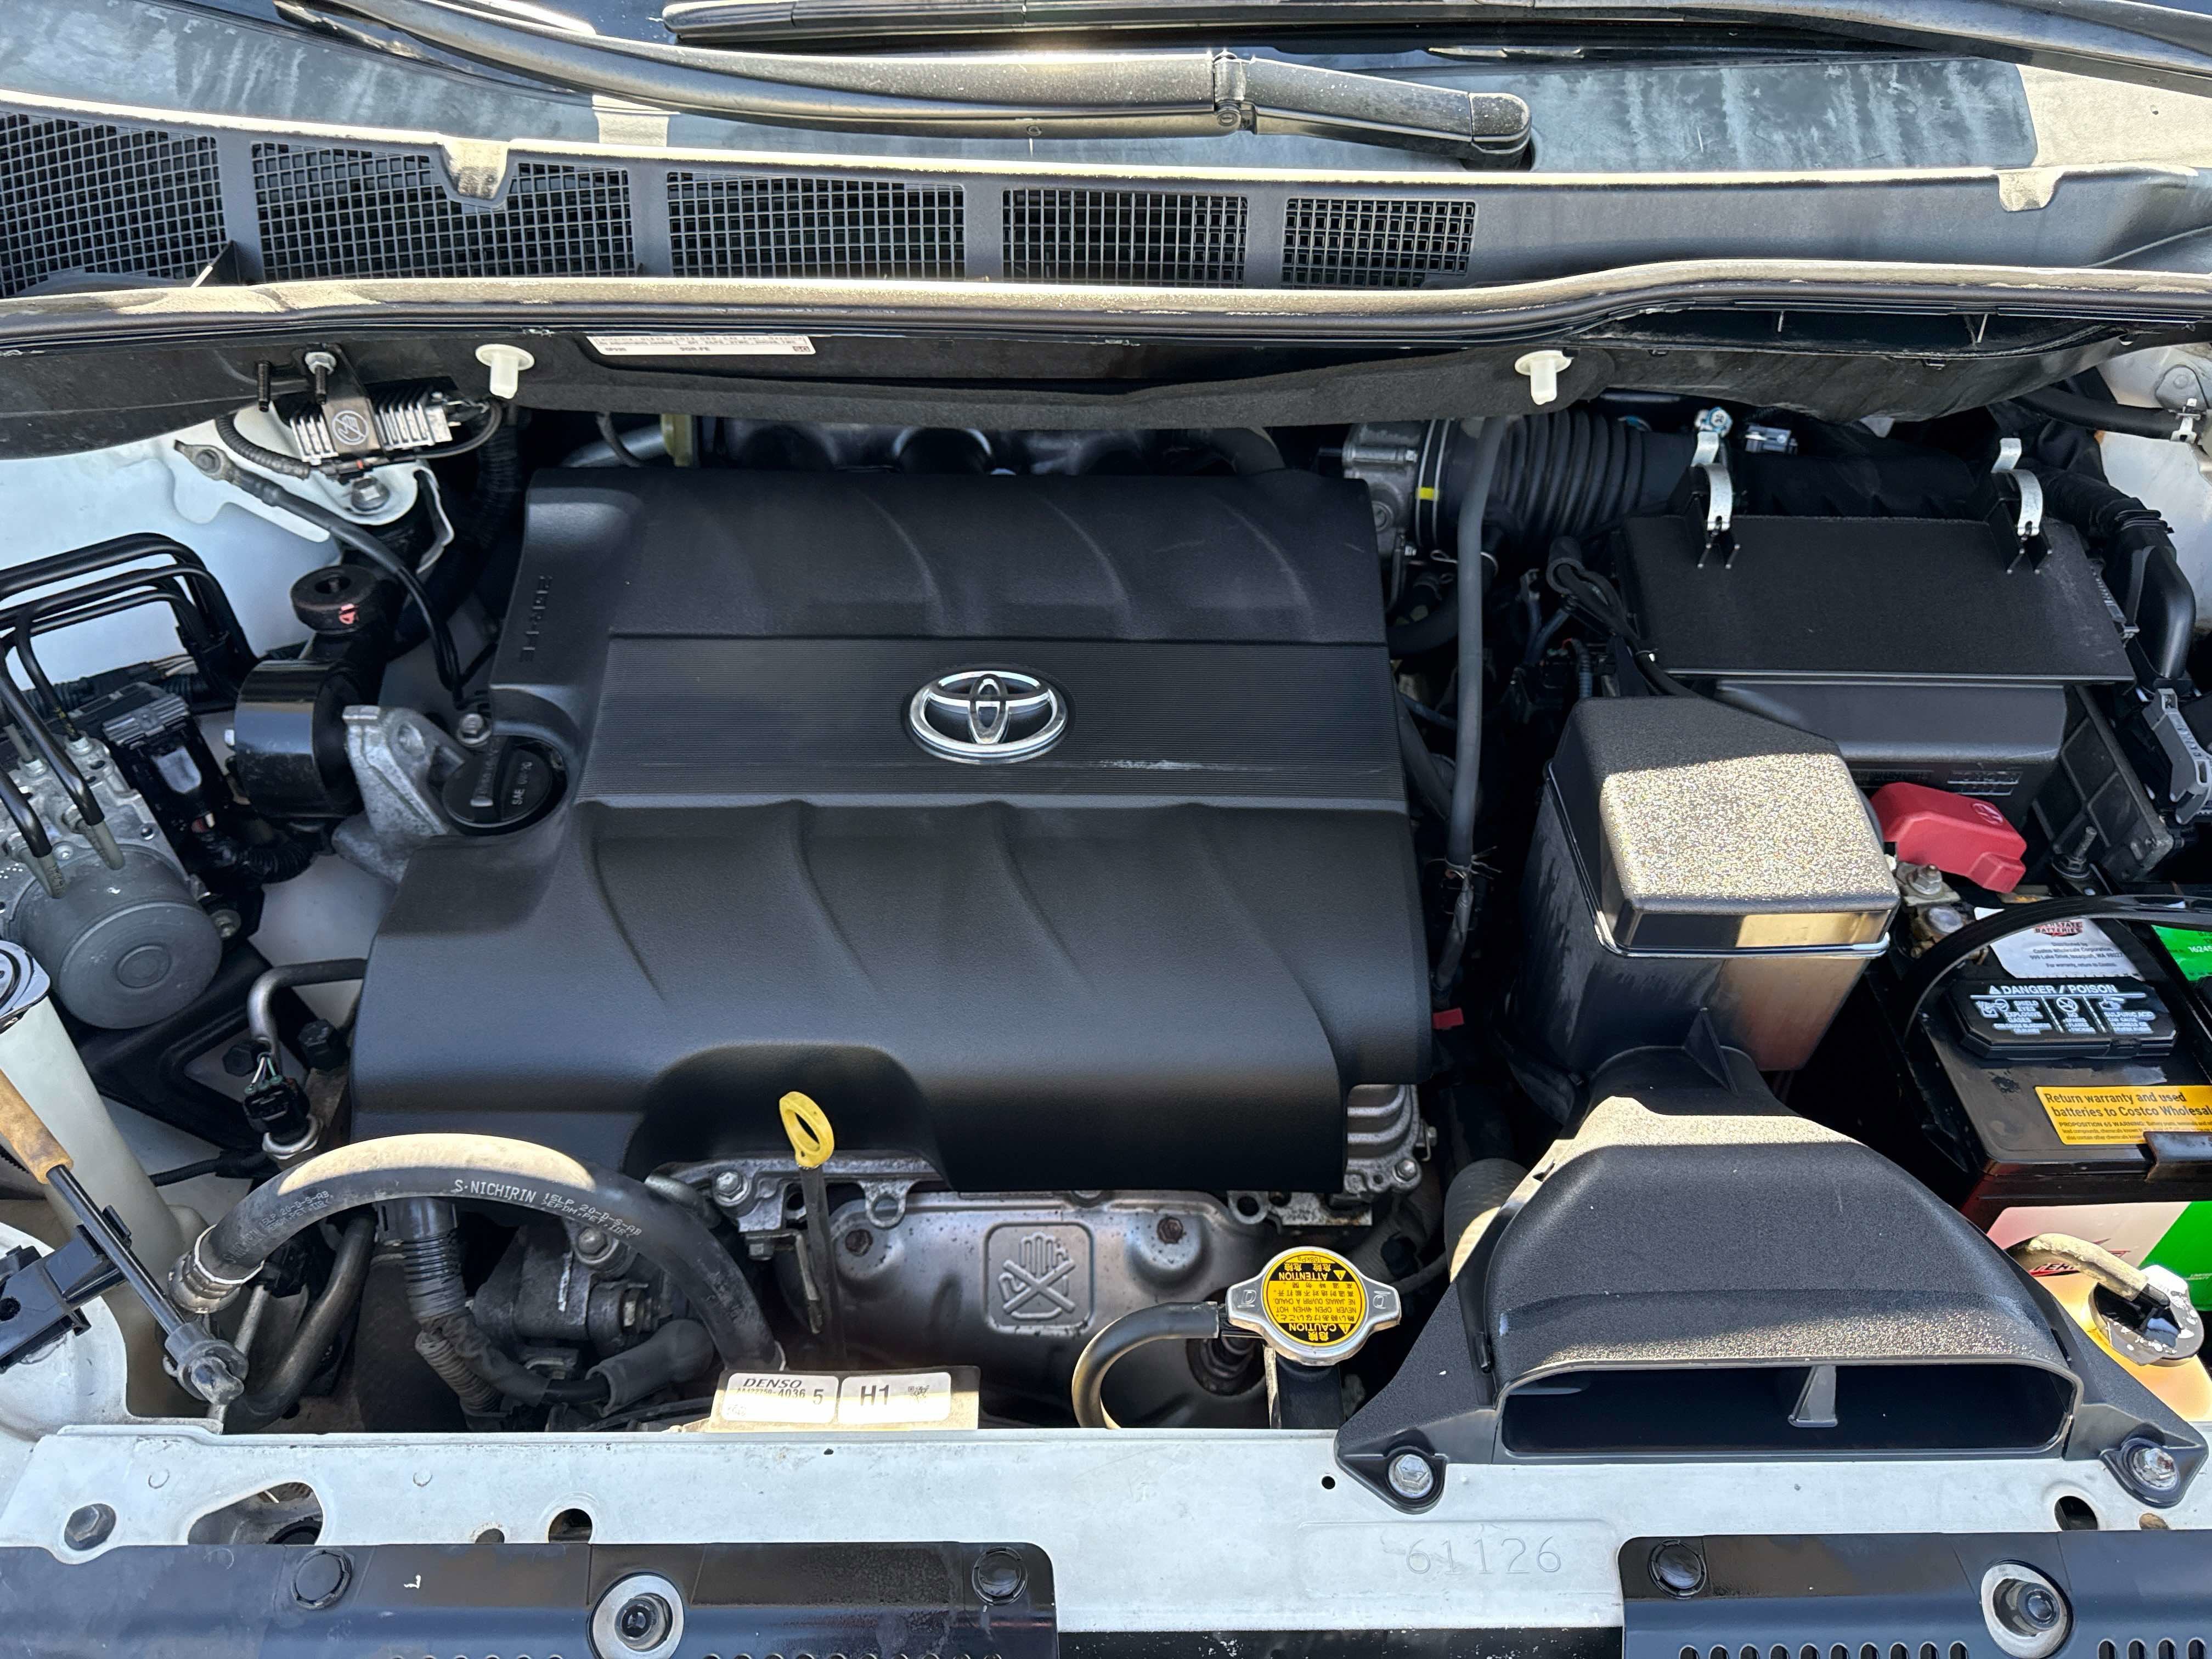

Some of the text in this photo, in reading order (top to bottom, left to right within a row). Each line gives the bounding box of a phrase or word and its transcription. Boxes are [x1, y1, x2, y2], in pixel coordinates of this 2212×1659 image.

[2001, 985, 2056, 994] DANGER
[2066, 985, 2119, 994] POISON
[2044, 1092, 2187, 1104] Return warranty and used
[2051, 1105, 2212, 1117] batteries to Costco Wholesal
[1279, 1272, 1328, 1280] ATTENTION
[1289, 1323, 1336, 1331] CAUTION
[743, 1378, 803, 1389] DENSO
[812, 1389, 824, 1405] 5
[860, 1385, 890, 1406] H1
[1406, 1535, 1562, 1575] 61126
